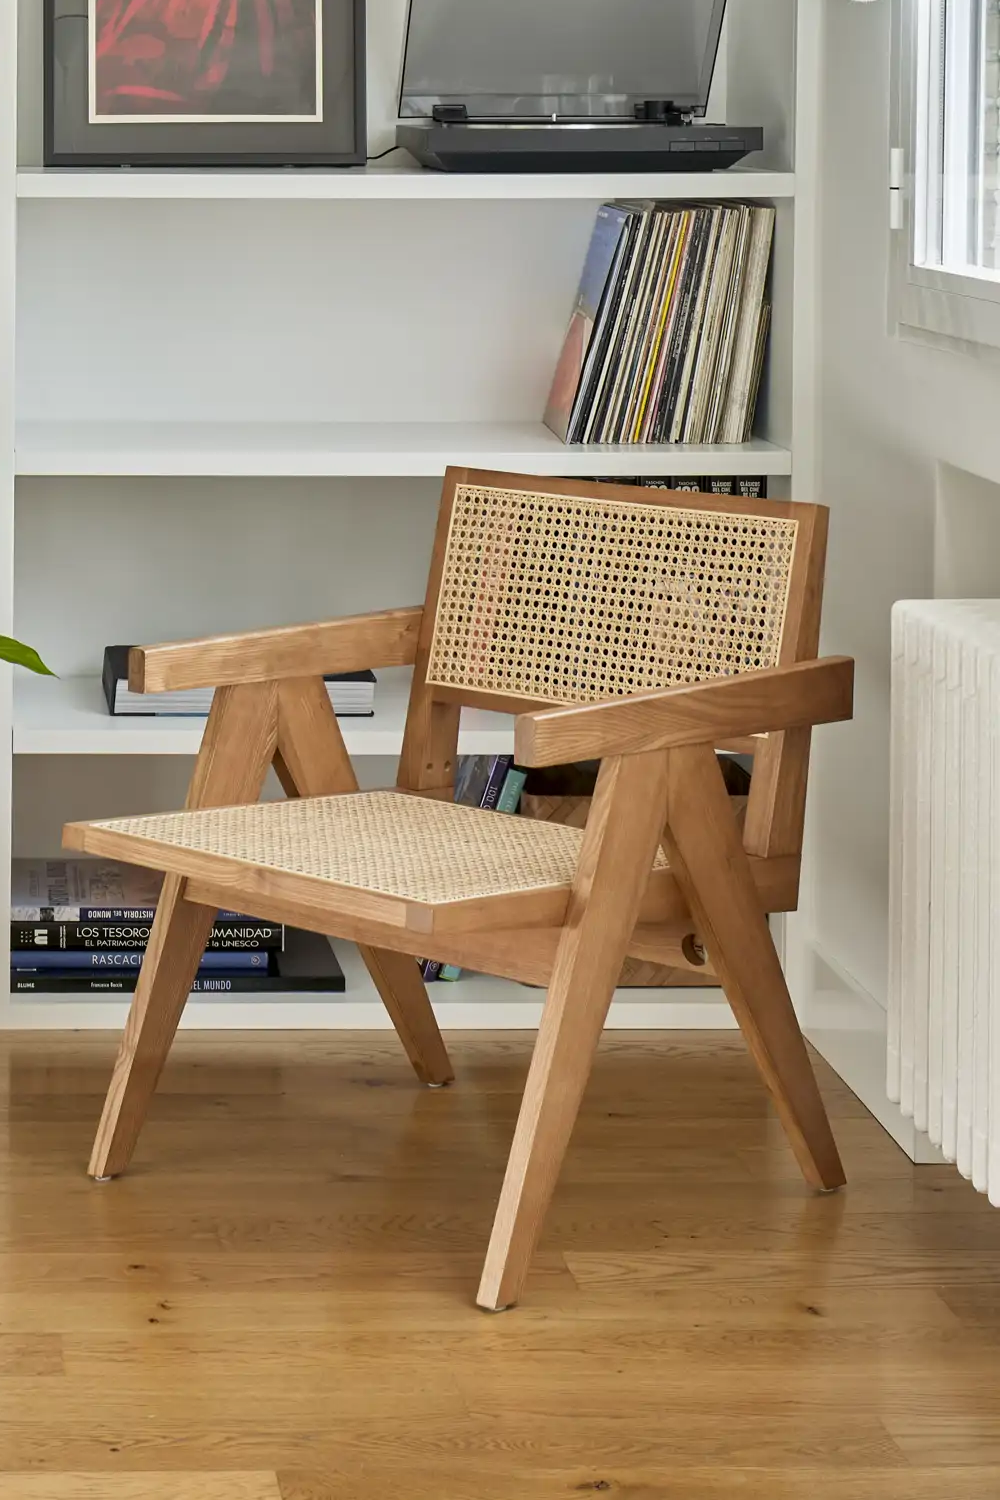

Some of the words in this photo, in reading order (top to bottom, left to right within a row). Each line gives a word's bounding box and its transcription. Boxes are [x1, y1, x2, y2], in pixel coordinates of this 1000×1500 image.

[711, 479, 732, 487] CLÁSICOS
[740, 479, 761, 487] CLÁSICOS
[88, 910, 111, 919] MUNDO
[124, 910, 154, 919] HISTORIA
[75, 927, 100, 938] LOS
[85, 939, 95, 947] EL
[221, 940, 260, 948] UNESCO
[204, 980, 232, 991] MUNDO
